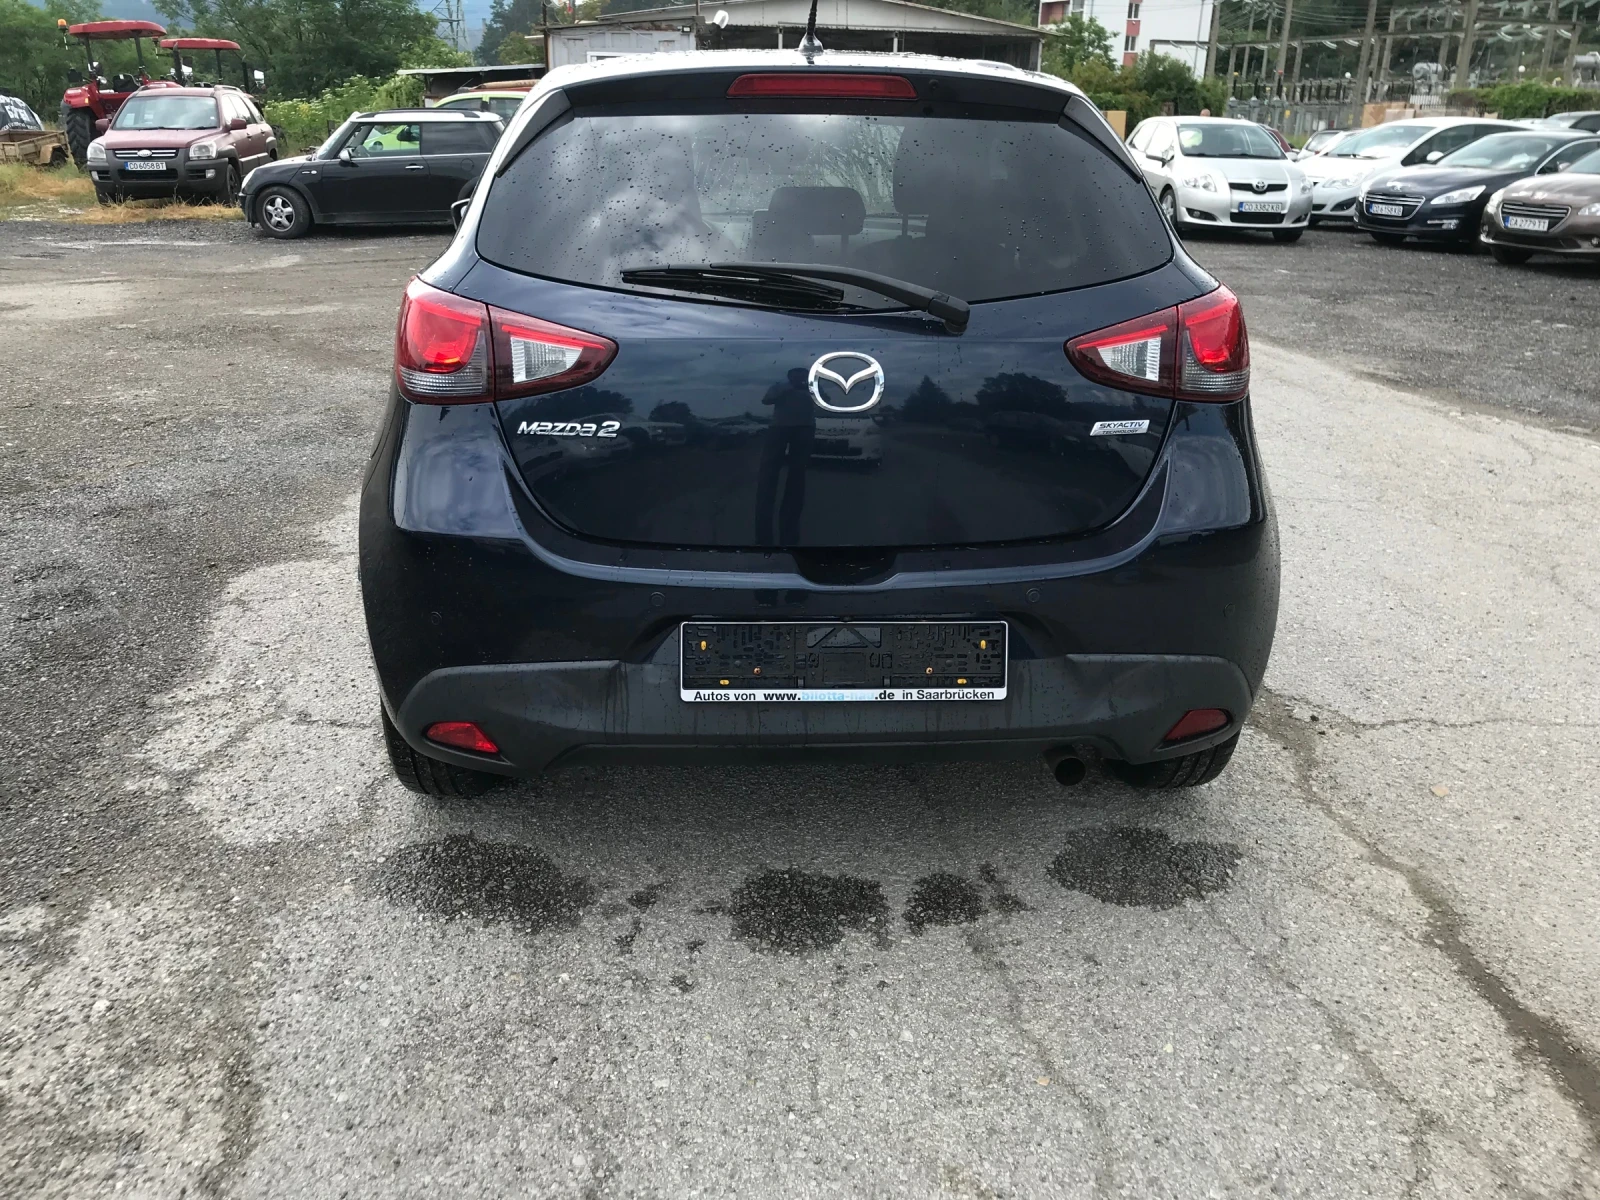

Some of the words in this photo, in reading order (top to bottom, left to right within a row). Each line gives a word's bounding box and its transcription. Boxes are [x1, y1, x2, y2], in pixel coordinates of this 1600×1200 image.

[1099, 421, 1144, 429] SKYACTIV
[694, 691, 730, 701] Autos
[734, 692, 756, 701] von
[902, 689, 913, 700] in
[916, 689, 995, 700] Saarbrücken
